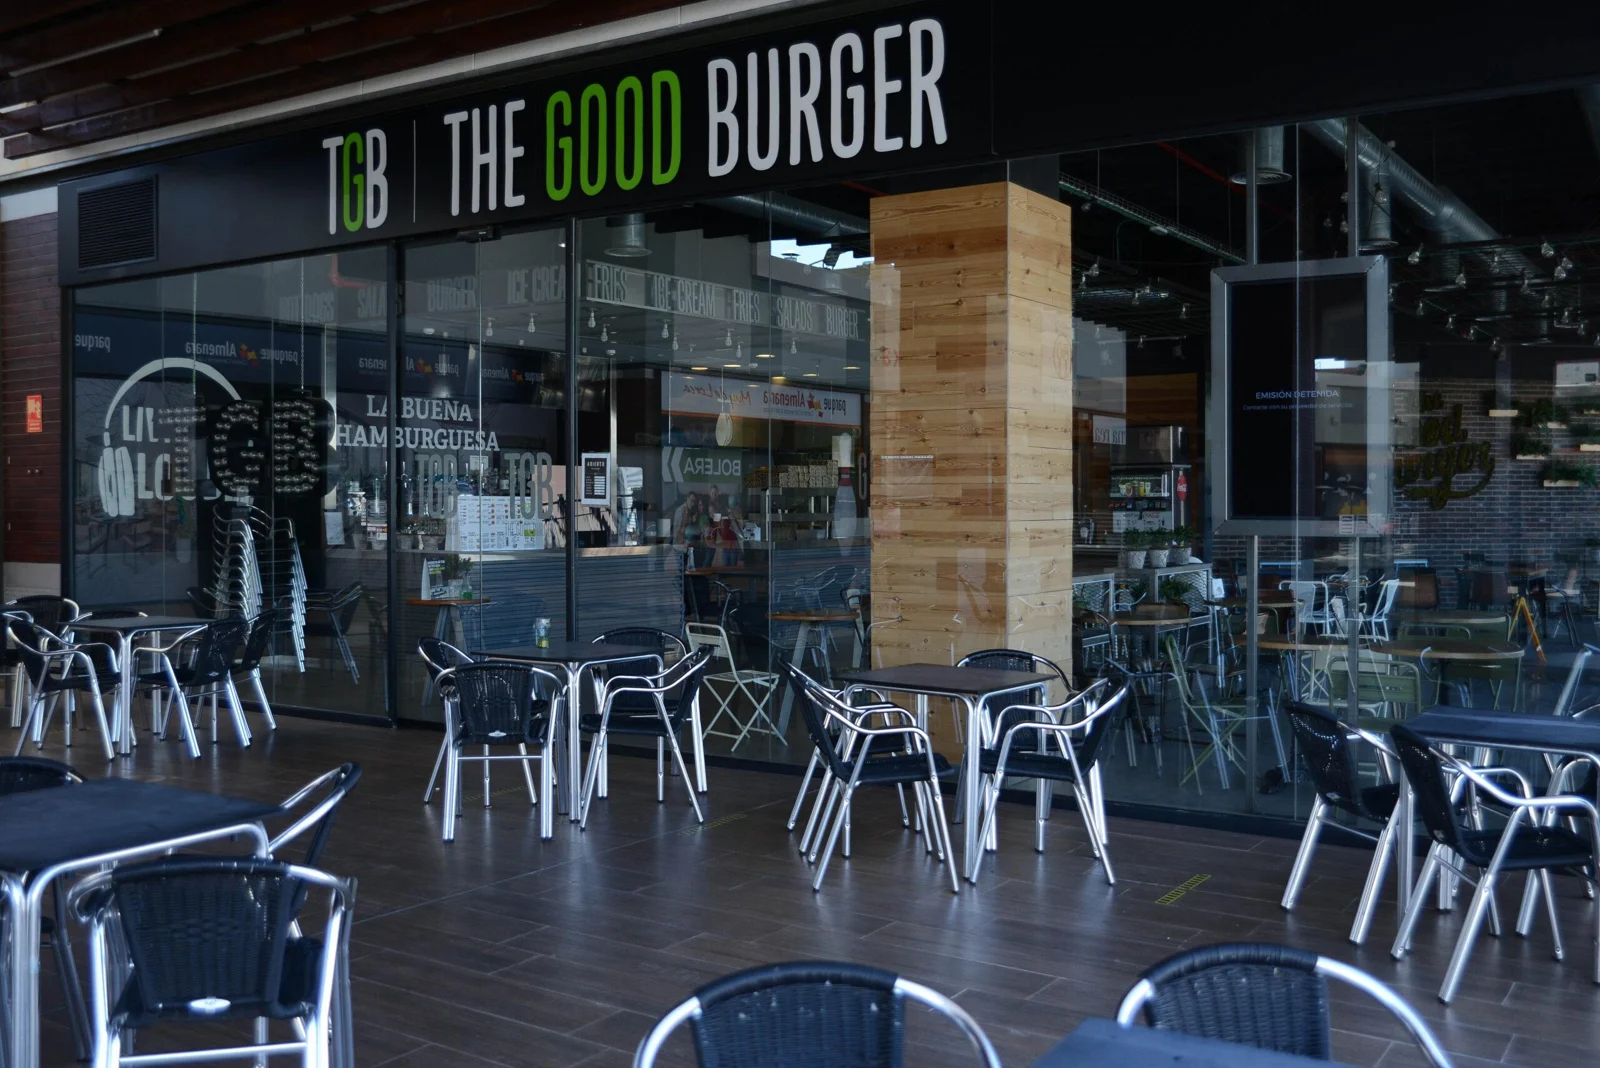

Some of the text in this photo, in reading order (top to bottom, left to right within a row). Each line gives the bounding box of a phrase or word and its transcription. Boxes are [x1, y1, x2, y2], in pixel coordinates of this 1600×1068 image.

[443, 18, 949, 216] THE GOOD BURGER
[321, 127, 389, 235] TGB
[593, 263, 628, 303] FRIES
[677, 279, 716, 316] CREAM
[732, 289, 761, 323] FRIES
[776, 296, 813, 332] SALADS
[825, 304, 859, 340] BURGER
[401, 396, 474, 422] BUENA
[1255, 389, 1339, 400] EMISIÓN DETENIDA
[335, 423, 500, 451] HAMBURGUESA
[504, 451, 554, 520] TGB
